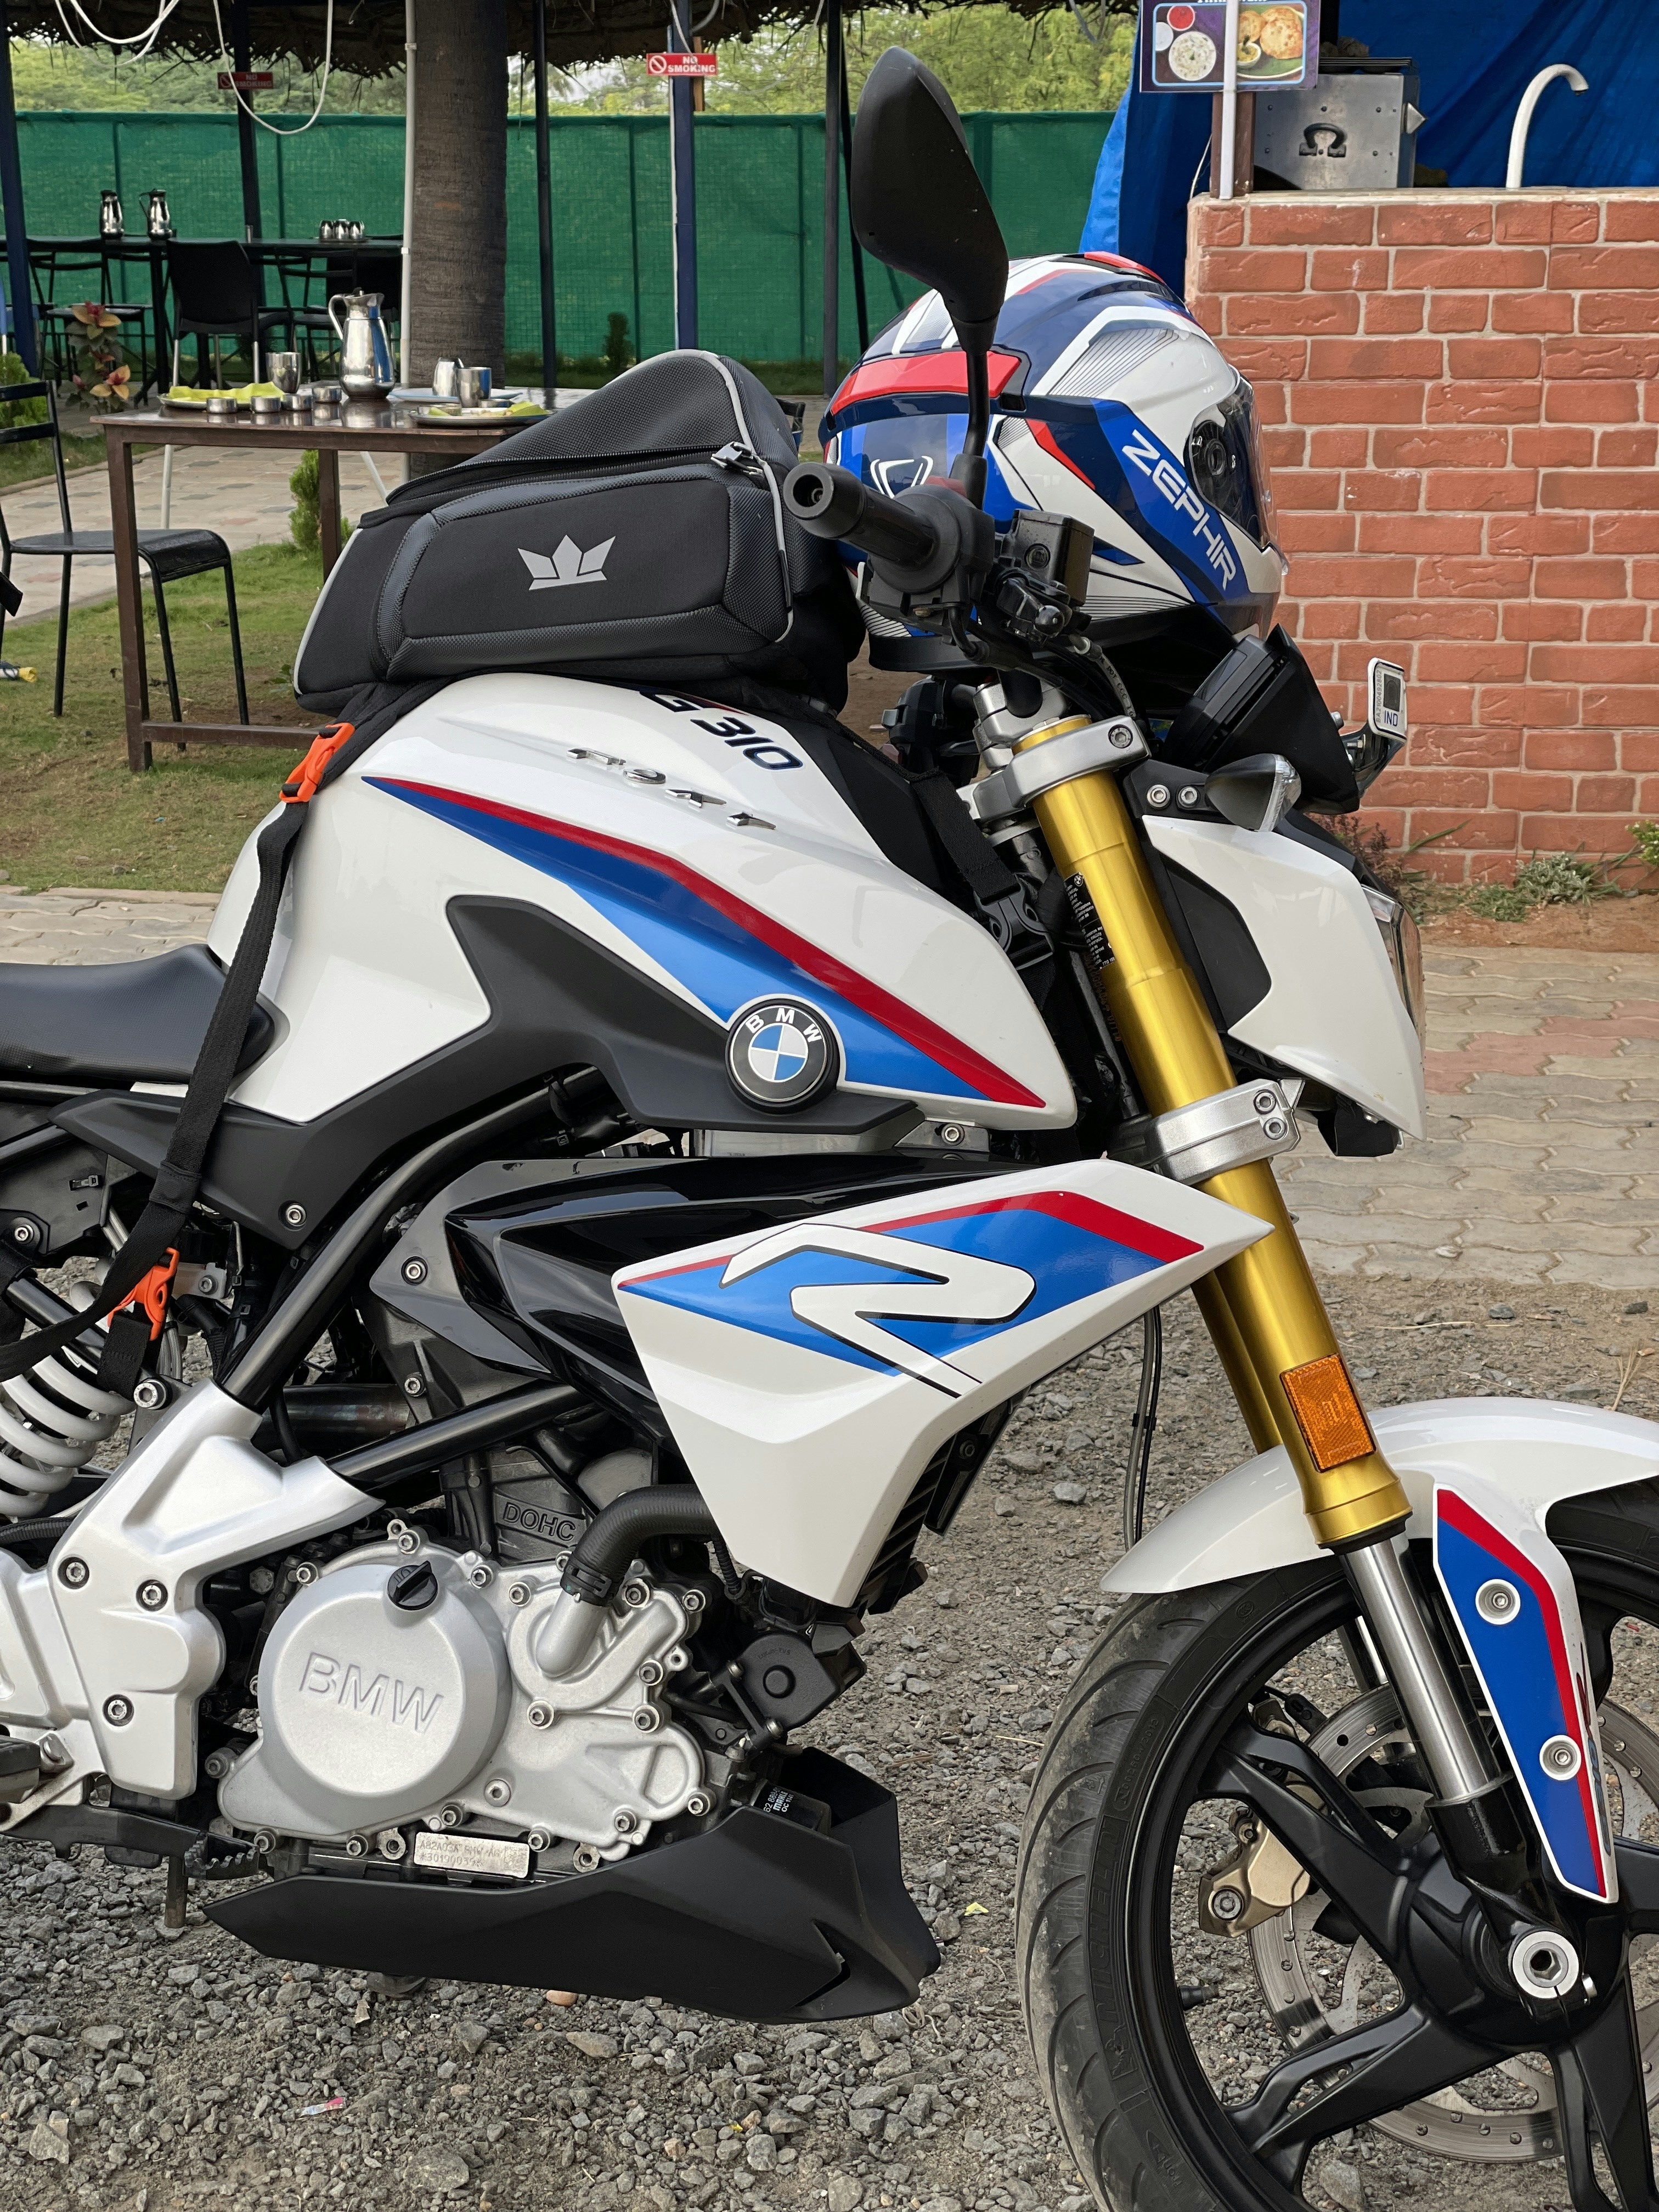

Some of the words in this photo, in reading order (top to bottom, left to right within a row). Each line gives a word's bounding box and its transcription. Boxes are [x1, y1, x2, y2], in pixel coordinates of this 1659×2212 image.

[1384, 709, 1399, 727] IND
[745, 1007, 822, 1042] BMW
[503, 1502, 576, 1541] DOHC
[298, 1651, 444, 1734] BMW
[781, 1803, 789, 1812] OC
